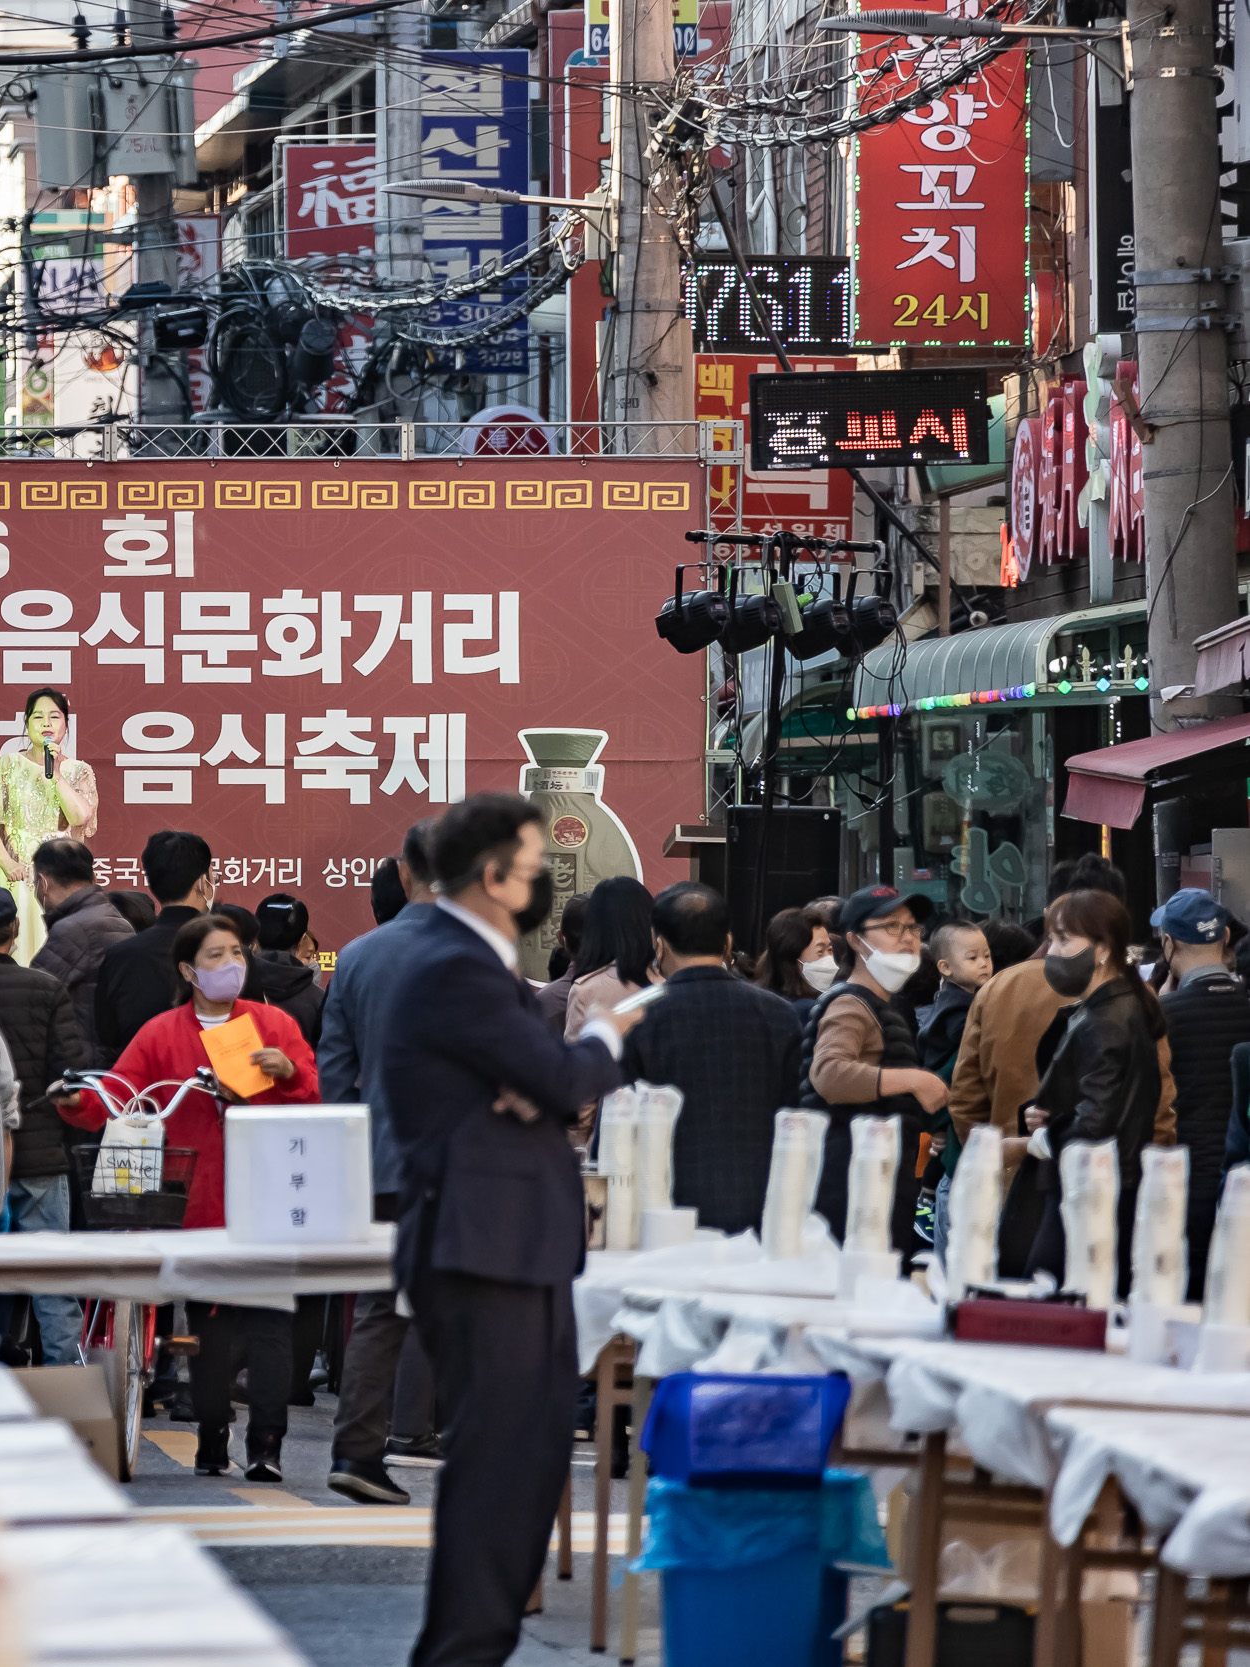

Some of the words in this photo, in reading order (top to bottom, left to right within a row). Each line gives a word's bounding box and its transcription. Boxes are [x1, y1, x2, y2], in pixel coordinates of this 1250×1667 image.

[893, 292, 989, 330] 24시
[102, 510, 196, 579] 회
[115, 708, 467, 805] 음식축제
[321, 856, 394, 888] 상인
[289, 1136, 308, 1227] 기부함
